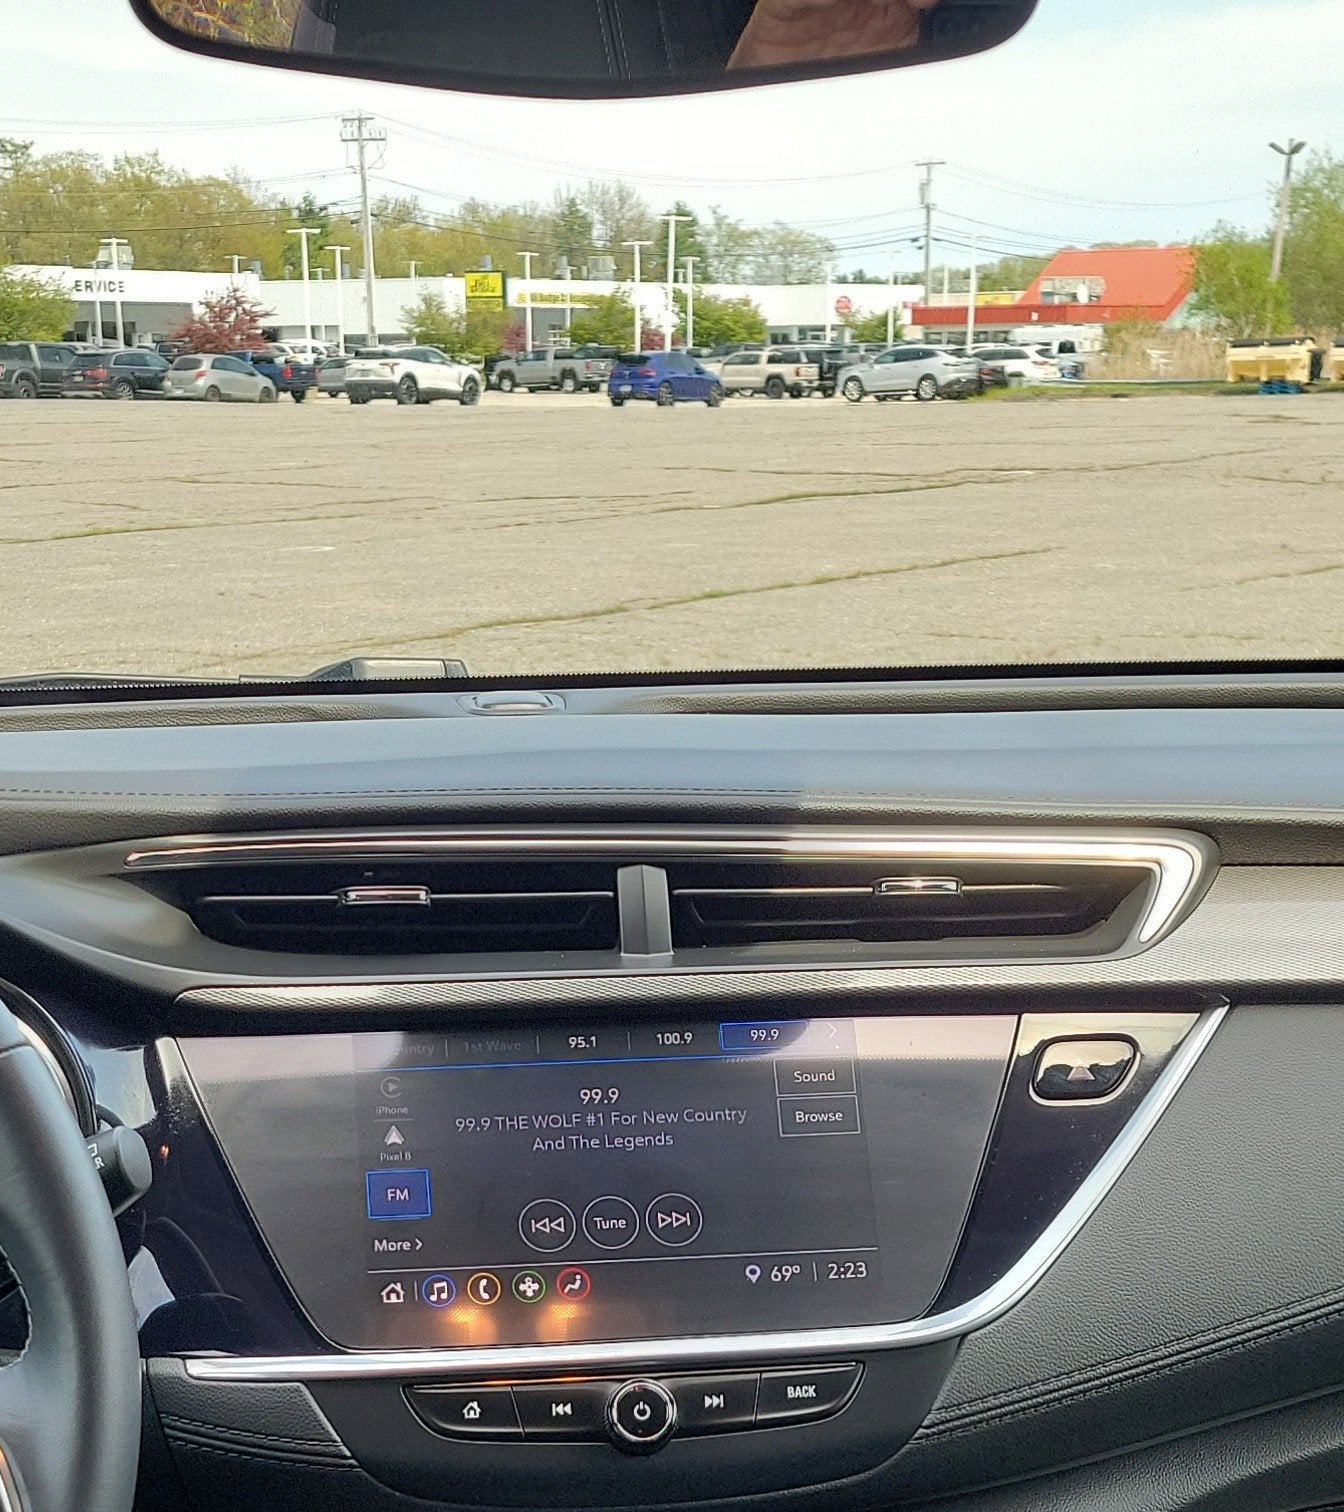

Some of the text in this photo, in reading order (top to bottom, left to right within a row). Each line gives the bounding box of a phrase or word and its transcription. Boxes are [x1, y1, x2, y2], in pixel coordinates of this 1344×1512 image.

[74, 279, 125, 293] ERVICE
[568, 1035, 597, 1049] 95.1
[656, 1032, 693, 1045] 100.9
[750, 1028, 779, 1042] 99.9
[486, 1040, 522, 1052] Wave
[793, 1069, 836, 1083] Sound
[579, 1087, 620, 1105] 99.9
[376, 1105, 409, 1115] iPhone
[795, 1109, 844, 1123] Browse
[455, 1107, 748, 1133] 99.9 THE WOLF #1 For New Country
[533, 1131, 674, 1151] And The Legends
[387, 1188, 410, 1202] FM
[593, 1216, 627, 1230] Tune
[374, 1238, 412, 1252] More
[827, 1261, 867, 1279] 2:23
[787, 1384, 817, 1399] BACK
